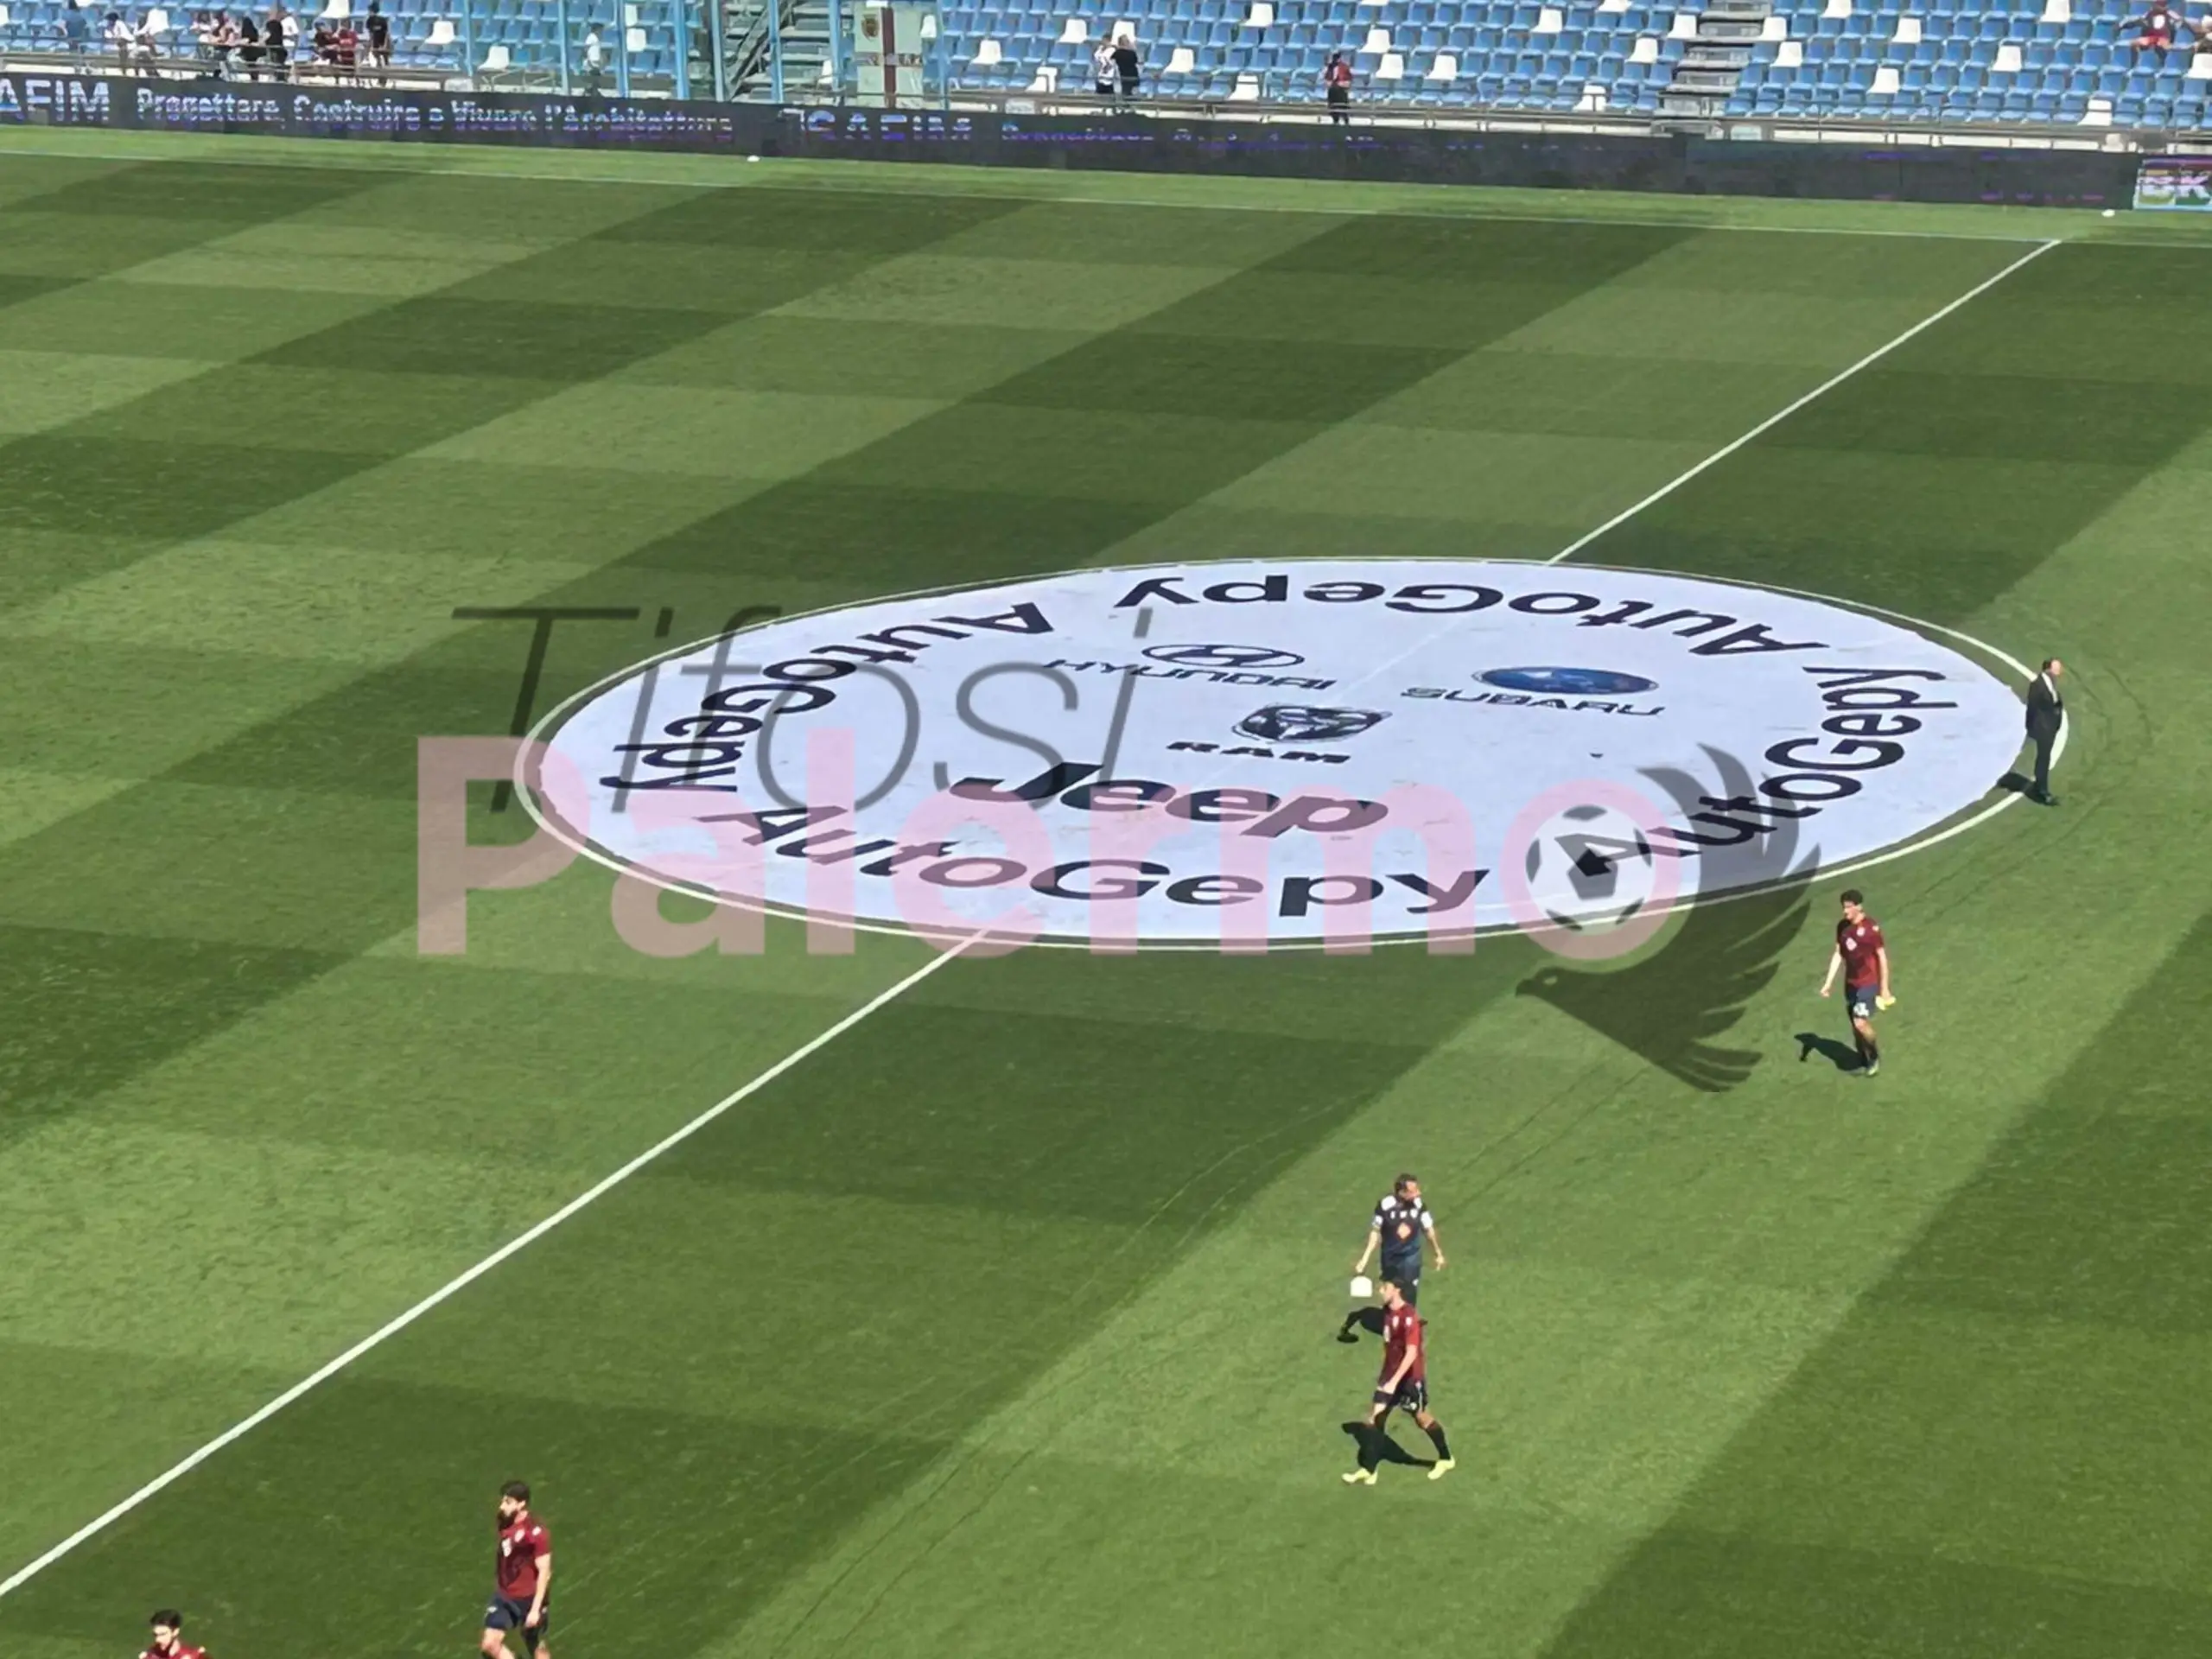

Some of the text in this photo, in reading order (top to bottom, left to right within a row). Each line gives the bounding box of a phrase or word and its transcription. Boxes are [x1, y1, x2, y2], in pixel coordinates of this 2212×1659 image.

[1113, 574, 1830, 655] AutoGepy
[599, 601, 1053, 792] AutoGepy
[1042, 658, 1338, 690] HYUNDAI
[1400, 686, 1666, 716] SUBARU
[1166, 740, 1352, 764] RAM
[1553, 664, 1959, 876] AutoGepy
[948, 760, 1389, 838] Jeep
[694, 805, 1491, 918] AutoGepy
